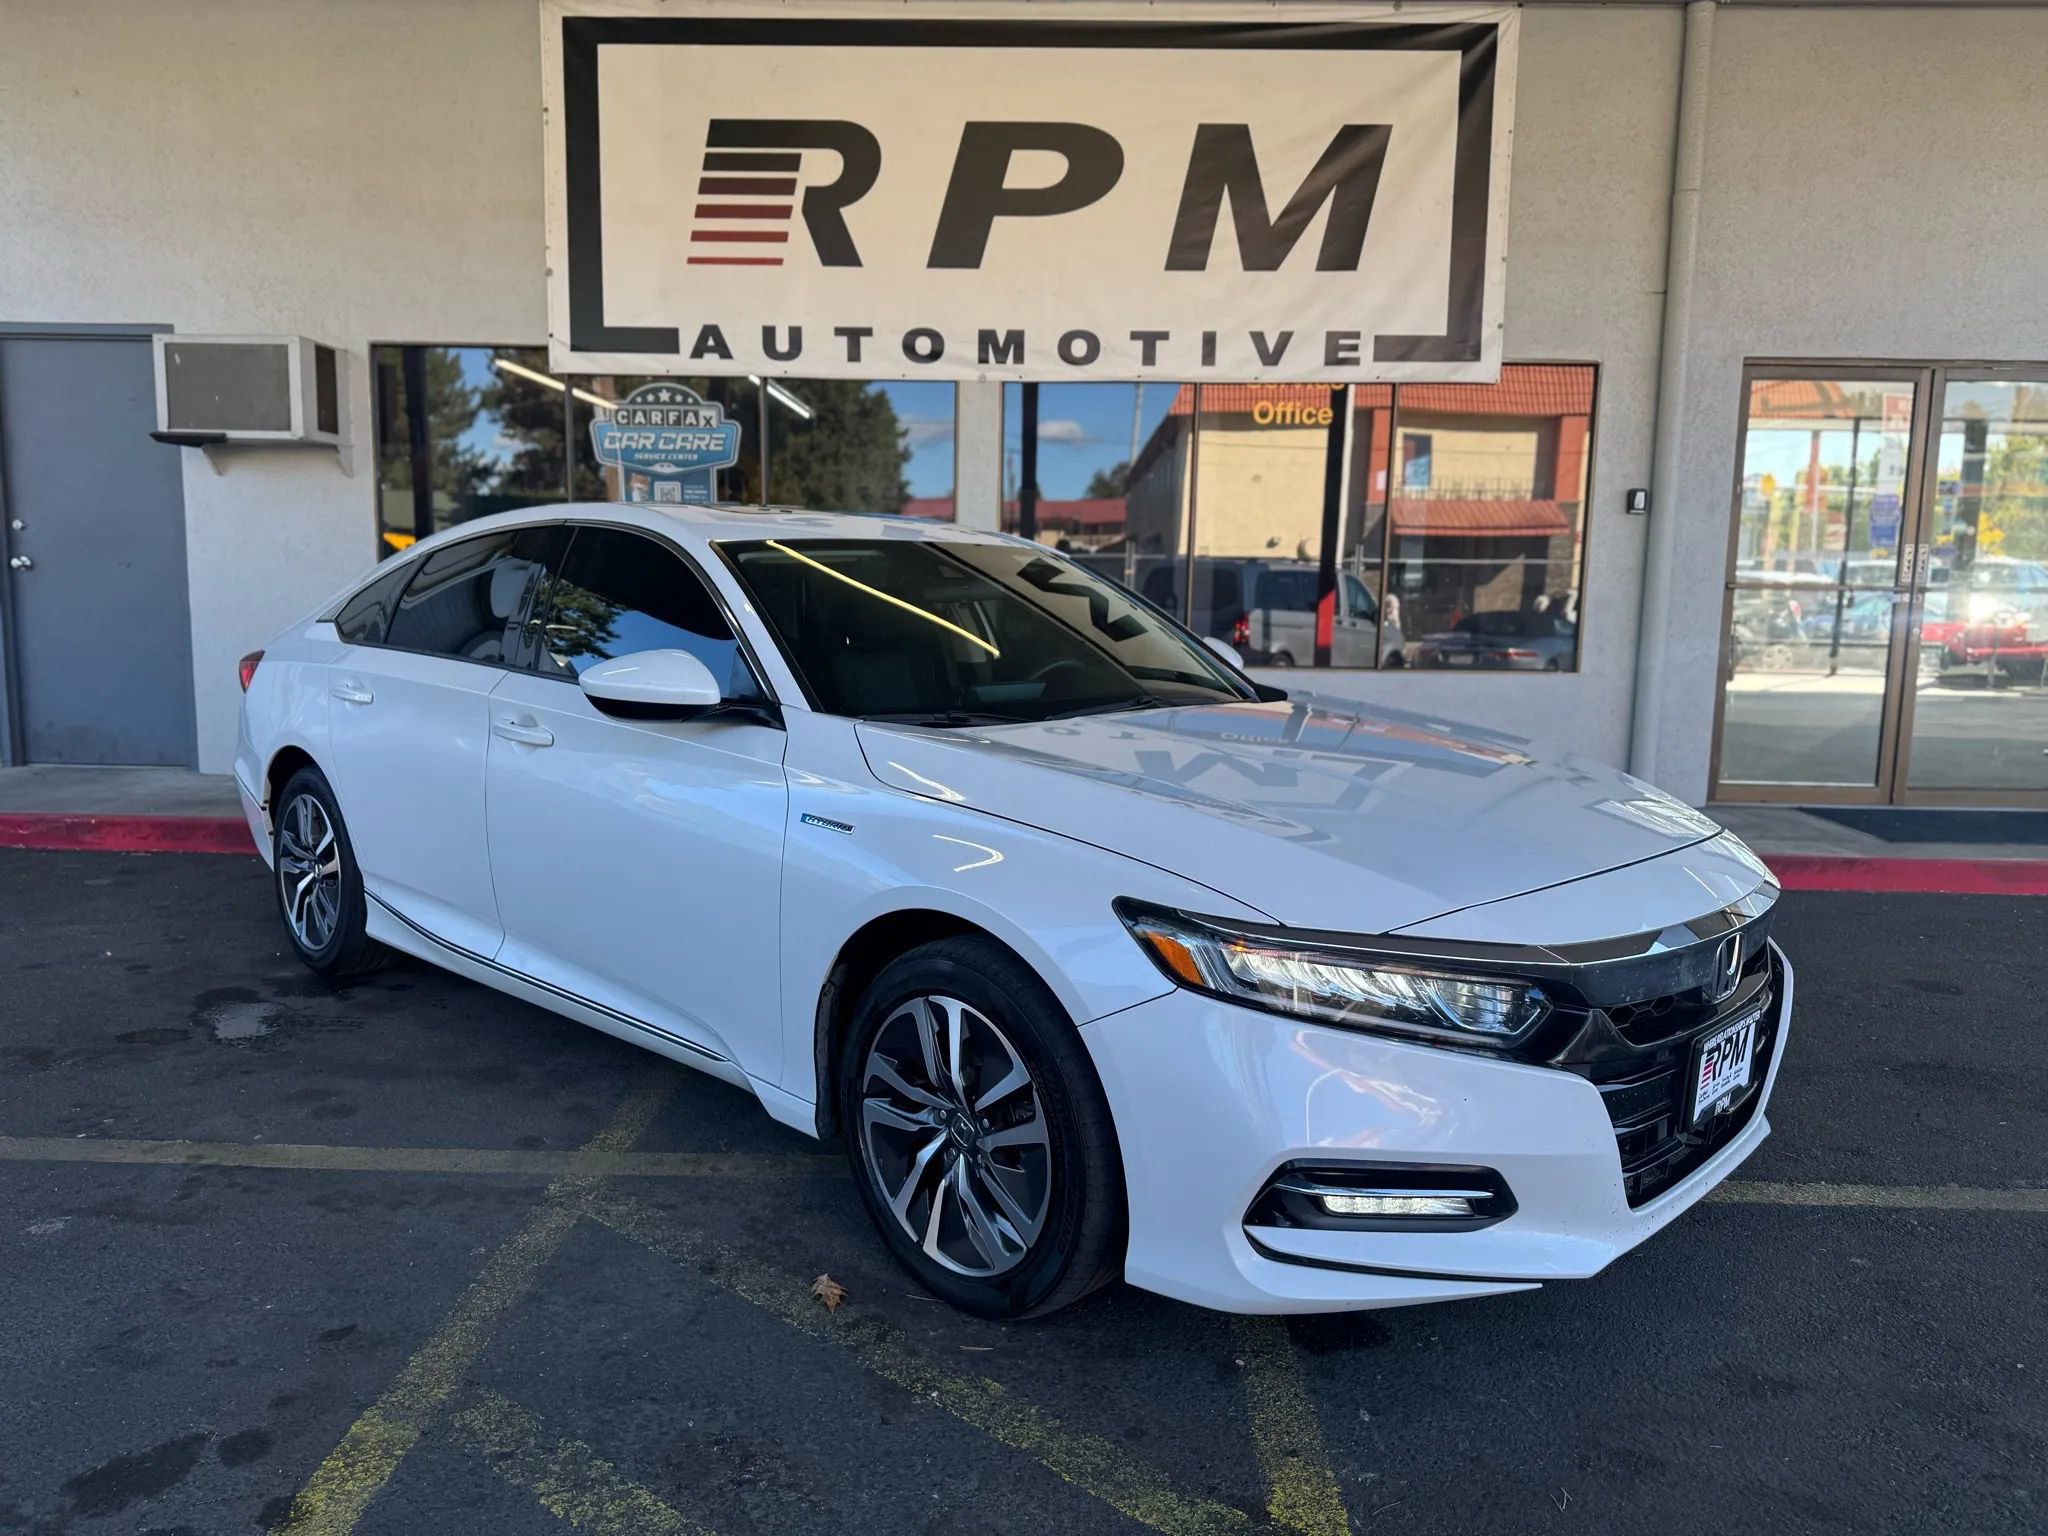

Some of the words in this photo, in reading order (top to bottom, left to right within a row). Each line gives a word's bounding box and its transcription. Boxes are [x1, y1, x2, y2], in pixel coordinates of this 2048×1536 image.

[687, 118, 1393, 272] RPM
[689, 323, 1364, 368] AUTOMOTIVE
[616, 409, 716, 428] CARFAX
[1252, 400, 1334, 425] Office
[603, 432, 656, 449] CAR
[658, 432, 726, 450] CARE
[1701, 1025, 1750, 1090] RPM
